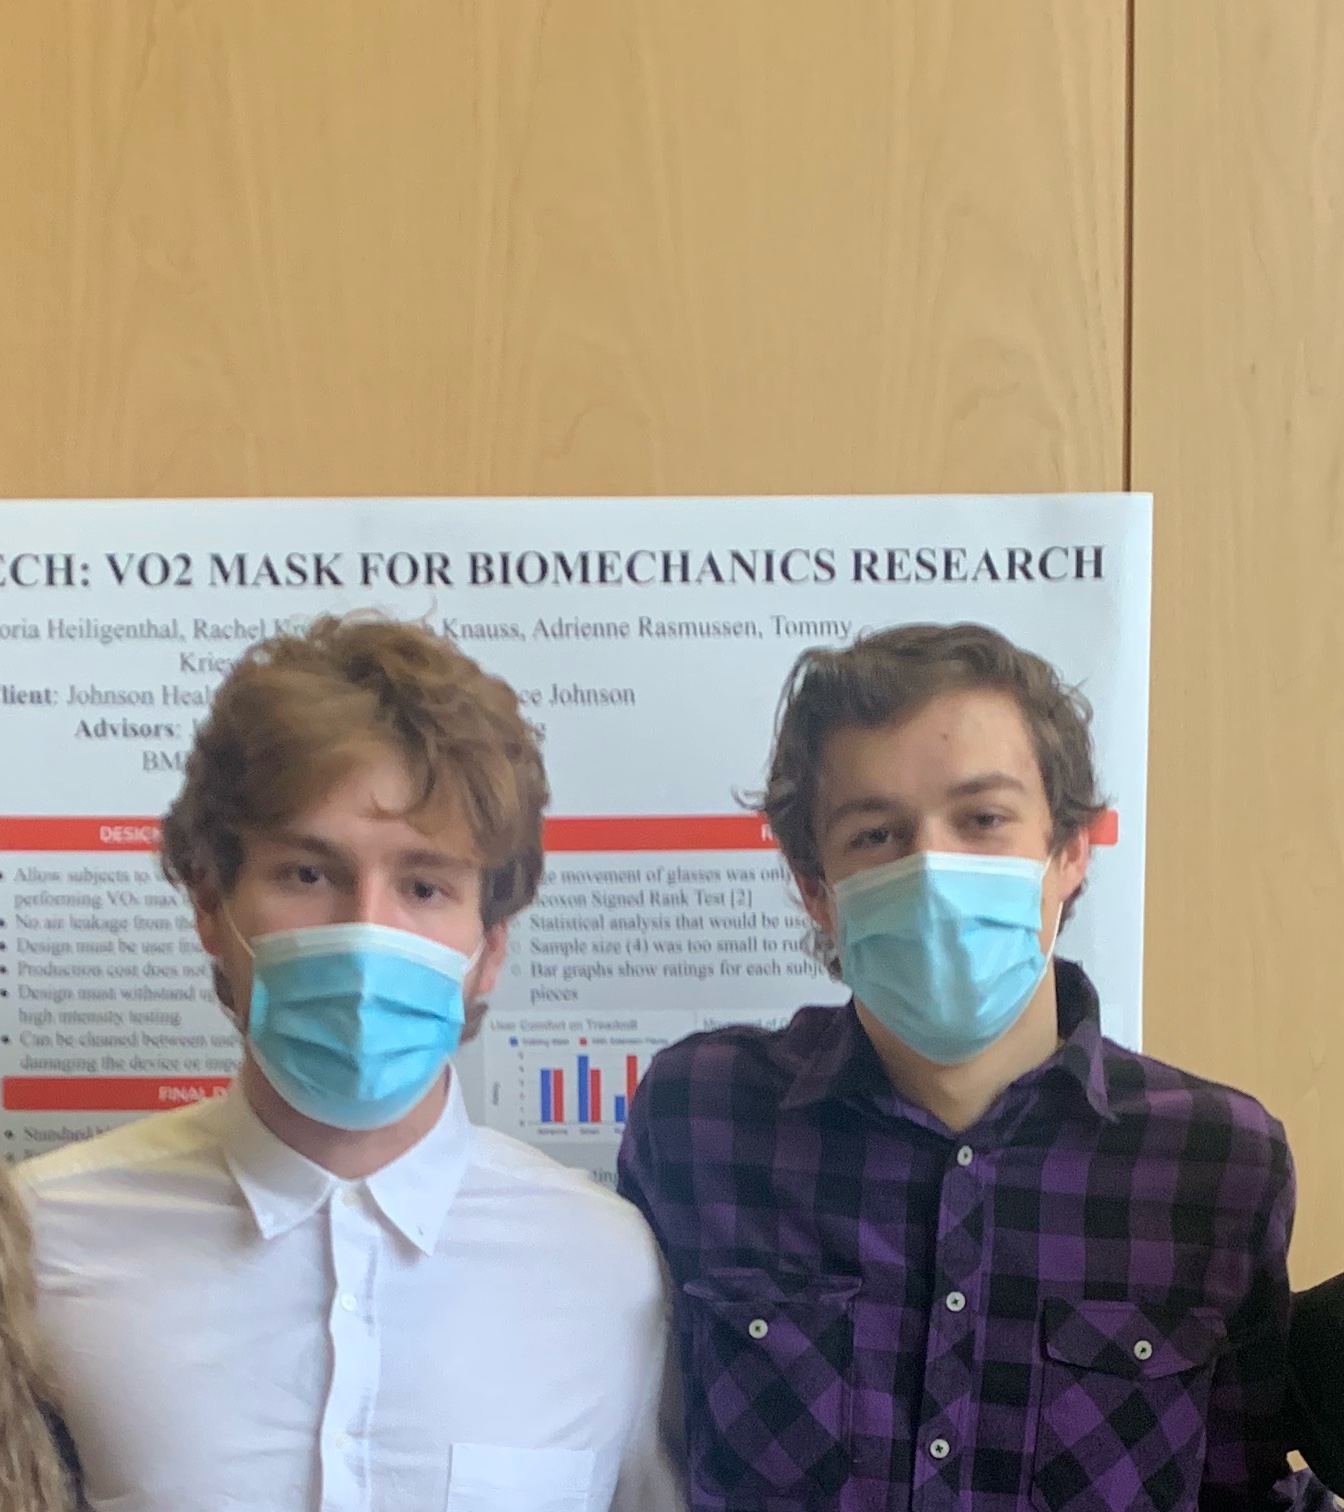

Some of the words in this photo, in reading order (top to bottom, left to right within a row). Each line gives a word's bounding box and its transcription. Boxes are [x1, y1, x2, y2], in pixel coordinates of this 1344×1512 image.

[104, 552, 193, 587] VO2
[208, 551, 345, 588] MASK
[357, 550, 455, 586] FOR
[467, 548, 837, 586] BIOMECHANICS
[850, 545, 1106, 583] RESEARCH
[47, 617, 186, 645] Heiligenthal,
[193, 617, 266, 640] Rachel
[442, 616, 526, 642] Knauss,
[531, 616, 631, 640] Adrienne
[638, 615, 764, 640] Rasmussen,
[770, 614, 852, 639] Tommy
[66, 684, 154, 707] Johnson
[162, 684, 212, 706] Heal
[548, 683, 636, 707] Johnson
[74, 717, 182, 740] Advisors:
[142, 750, 186, 772] BM
[560, 867, 642, 885] movement
[645, 865, 664, 884] of
[666, 865, 722, 887] glasses
[726, 869, 756, 883] was
[591, 889, 645, 913] Signed
[649, 889, 690, 908] Rank
[694, 888, 727, 907] Test
[730, 888, 753, 909] [2]
[528, 914, 605, 932] Statistical
[609, 914, 672, 936] analysis
[675, 913, 705, 931] that
[708, 912, 757, 930] would
[761, 911, 780, 930] be
[528, 937, 587, 961] Sample
[591, 938, 622, 956] size
[625, 936, 649, 958] (4)
[653, 940, 683, 955] was
[687, 938, 712, 955] too
[716, 935, 758, 953] small
[762, 937, 778, 953] to
[530, 959, 559, 977] Bar
[562, 958, 613, 982] graphs
[617, 958, 657, 977] show
[662, 958, 716, 981] ratings
[720, 957, 743, 976] for
[746, 957, 782, 976] each
